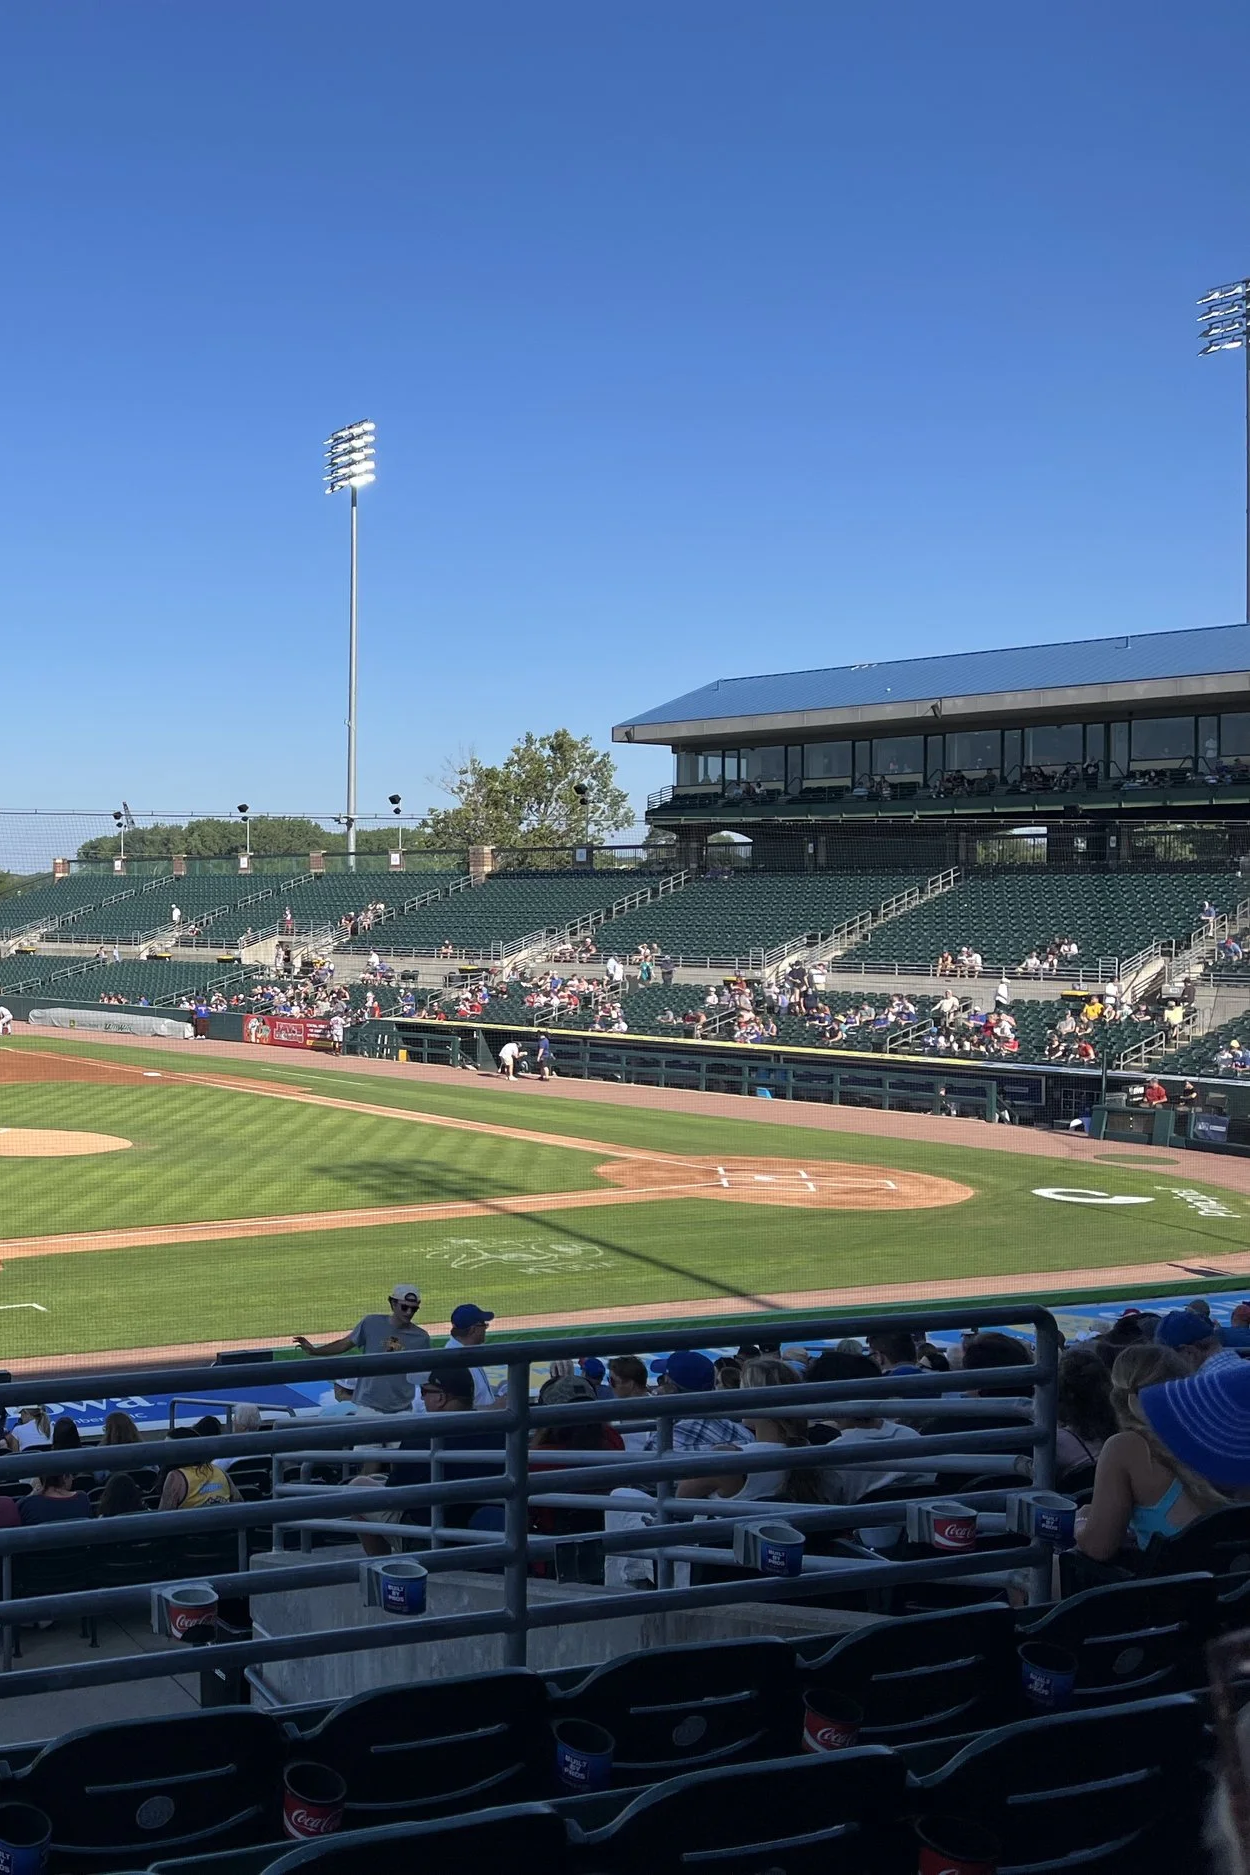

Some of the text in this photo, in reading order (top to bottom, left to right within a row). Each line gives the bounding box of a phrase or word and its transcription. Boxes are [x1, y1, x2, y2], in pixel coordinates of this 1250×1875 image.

[768, 1549, 786, 1557] BUILT
[768, 1559, 786, 1567] PROS
[388, 1584, 404, 1592] BUILT
[388, 1594, 405, 1602] PROS
[564, 1754, 587, 1767] BUILT
[564, 1767, 586, 1780] PROS
